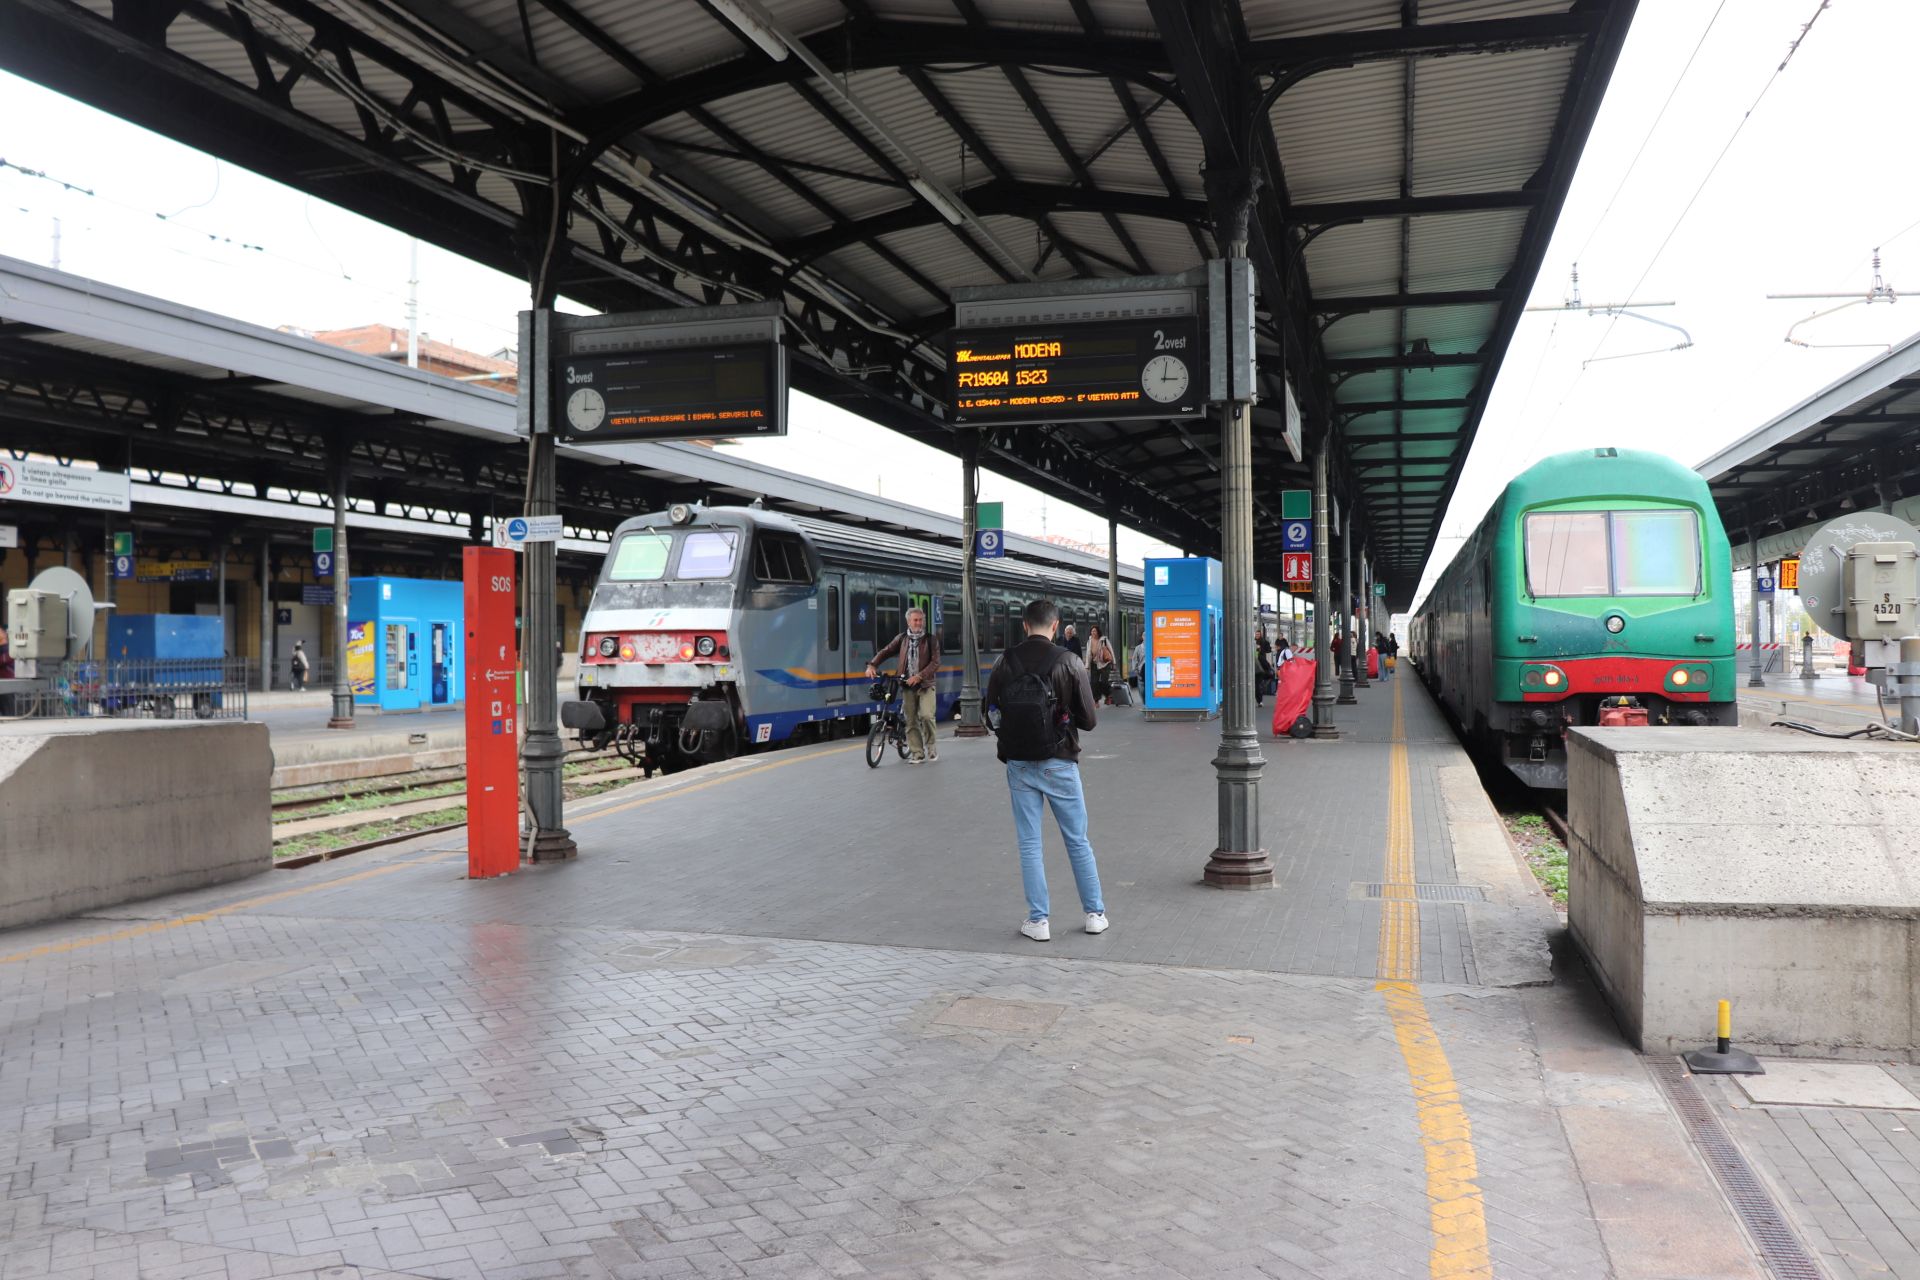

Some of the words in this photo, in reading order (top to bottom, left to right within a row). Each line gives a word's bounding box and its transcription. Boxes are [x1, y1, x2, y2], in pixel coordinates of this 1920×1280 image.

[1014, 342, 1061, 359] MODENA
[1015, 369, 1048, 386] 15:23
[1009, 397, 1038, 405] MODENA
[1087, 393, 1119, 401] VIETATO
[610, 417, 637, 425] VIETATO
[639, 414, 686, 424] ATTRAVERSARE
[719, 411, 749, 419] SERVIRSI
[750, 410, 764, 418] DEL
[22, 488, 32, 496] Do
[55, 492, 79, 502] beyond
[91, 496, 111, 505] yellow
[1292, 526, 1302, 539] 2
[985, 534, 994, 547] 3
[319, 556, 327, 567] 4
[491, 575, 511, 593] SOS
[1884, 593, 1890, 603] S
[1873, 603, 1901, 615] 4520
